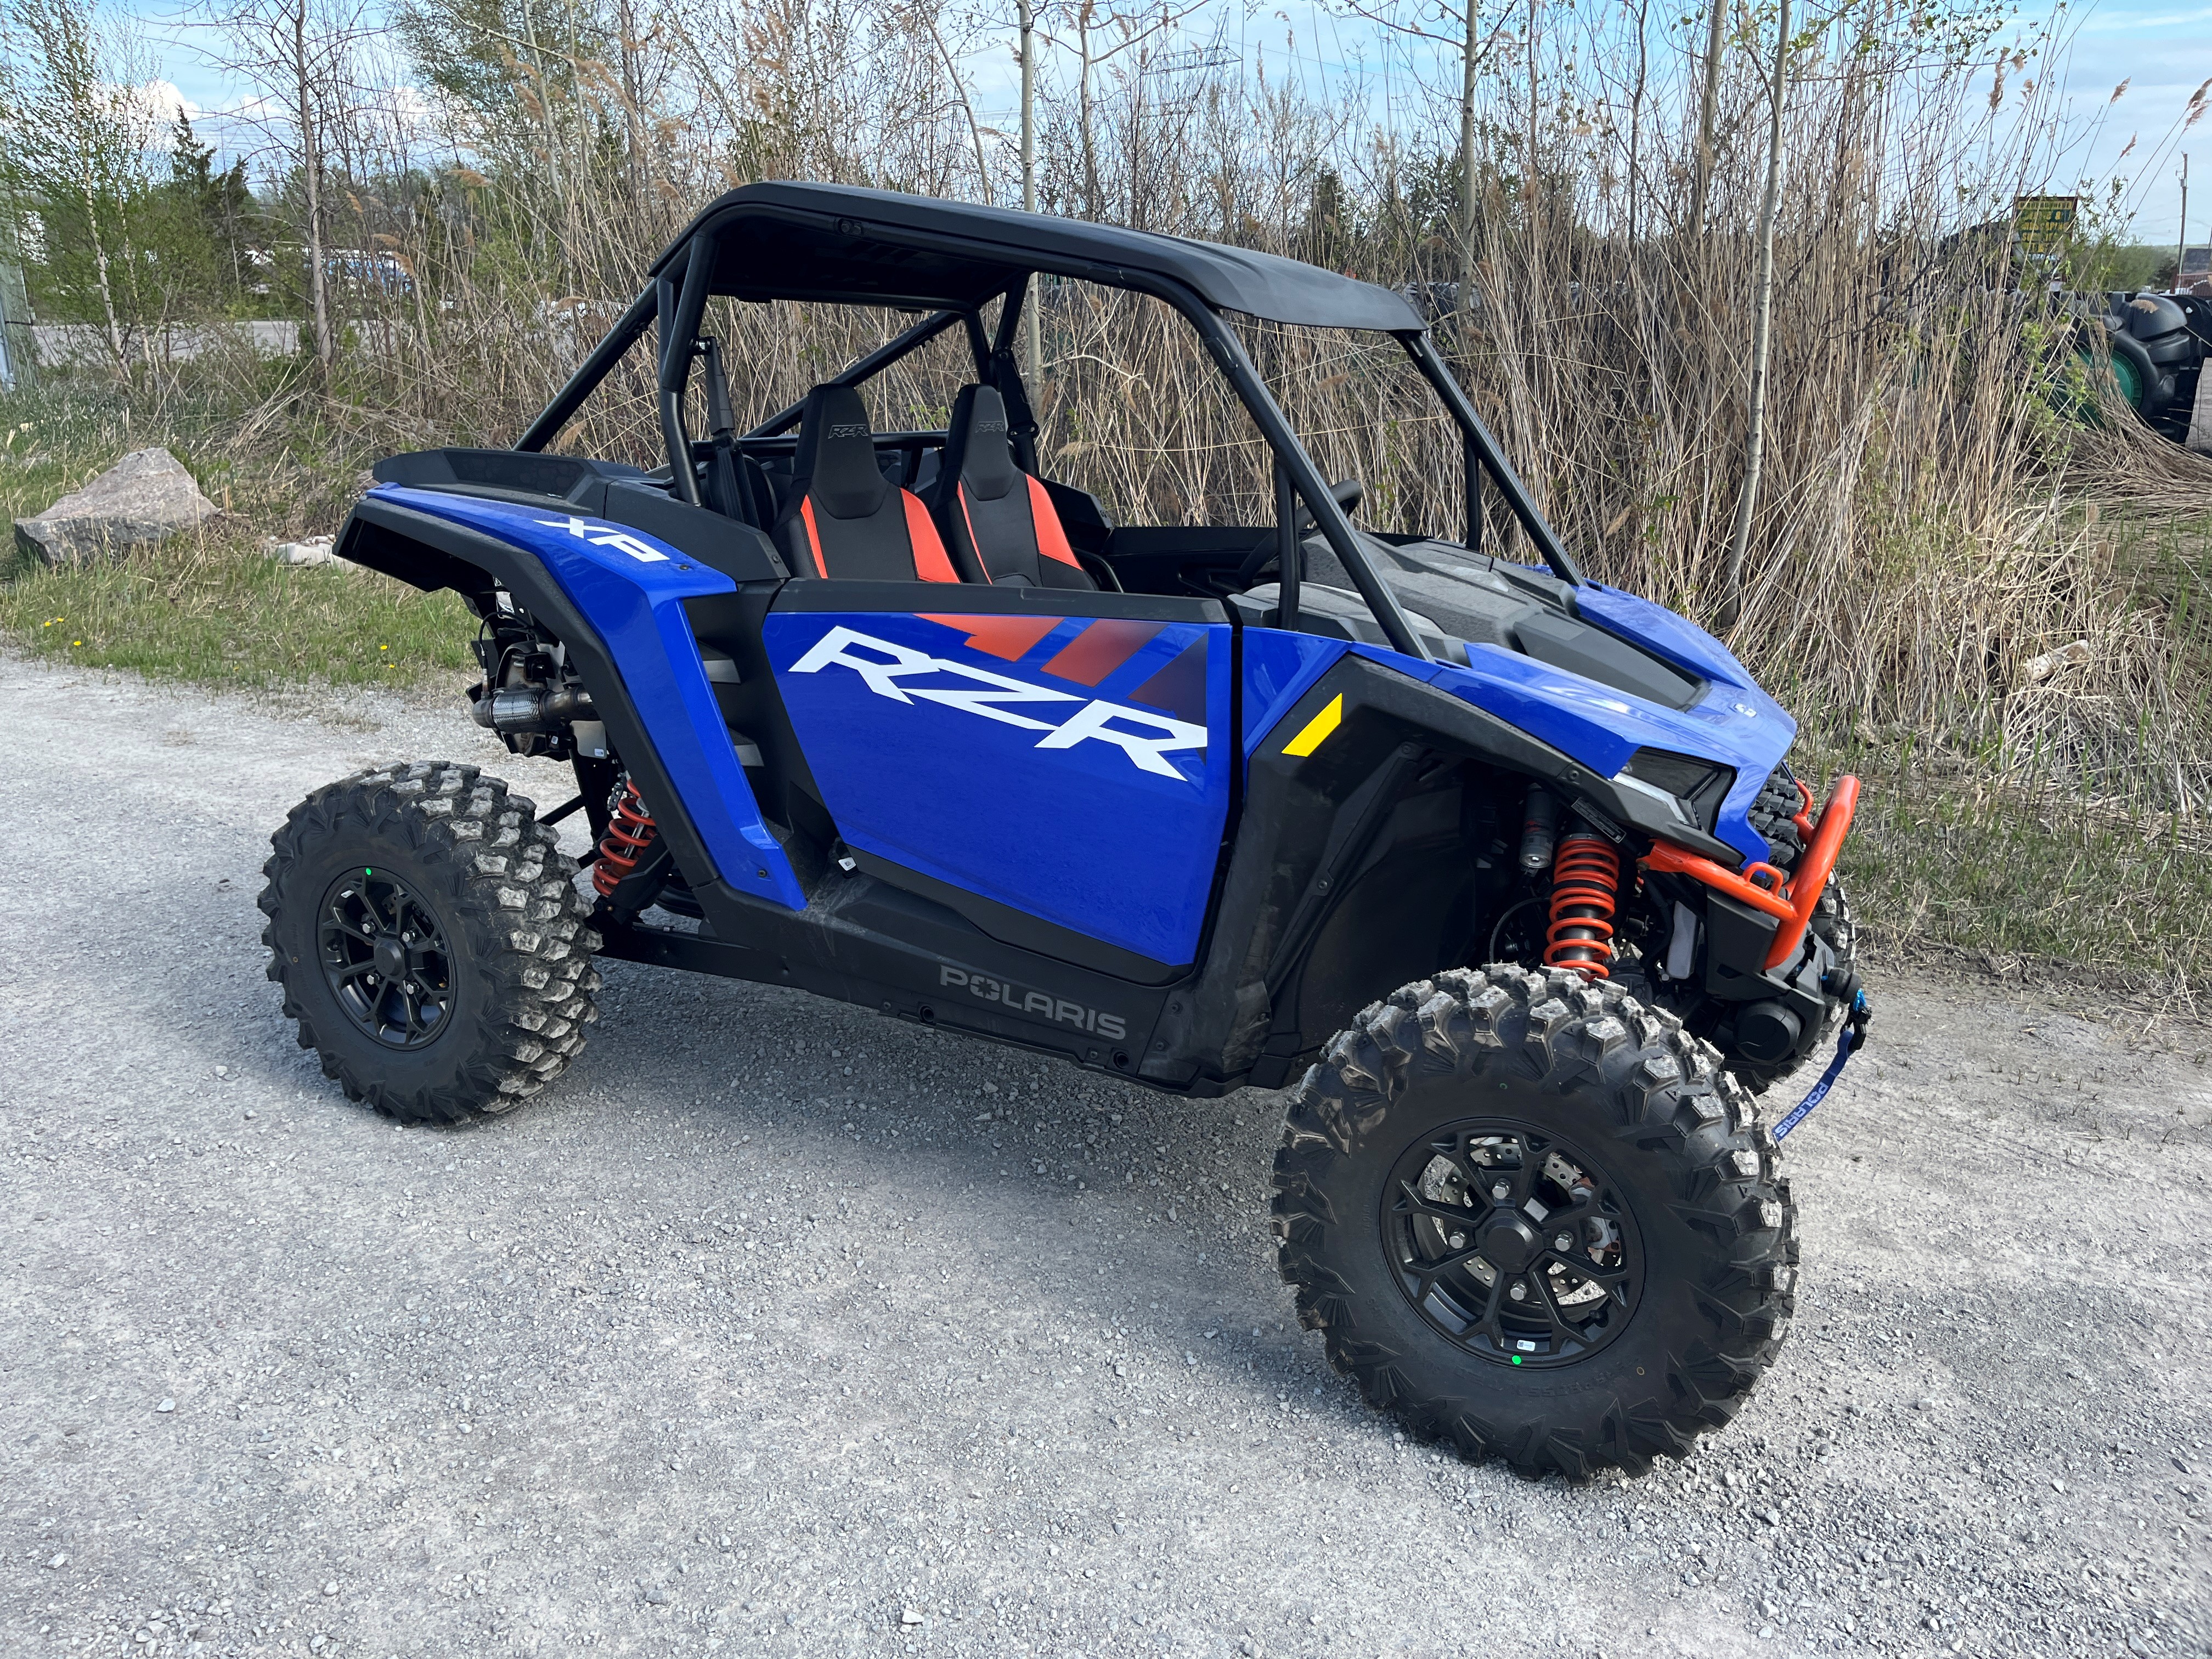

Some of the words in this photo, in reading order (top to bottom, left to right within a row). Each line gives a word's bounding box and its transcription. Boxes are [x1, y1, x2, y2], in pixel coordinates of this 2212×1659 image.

[828, 424, 868, 439] RZR
[975, 421, 1005, 433] RZR
[533, 517, 670, 562] XP
[788, 625, 1207, 781] RZR
[940, 964, 1126, 1040] POLARIS
[1774, 1081, 1829, 1137] POLARIS
